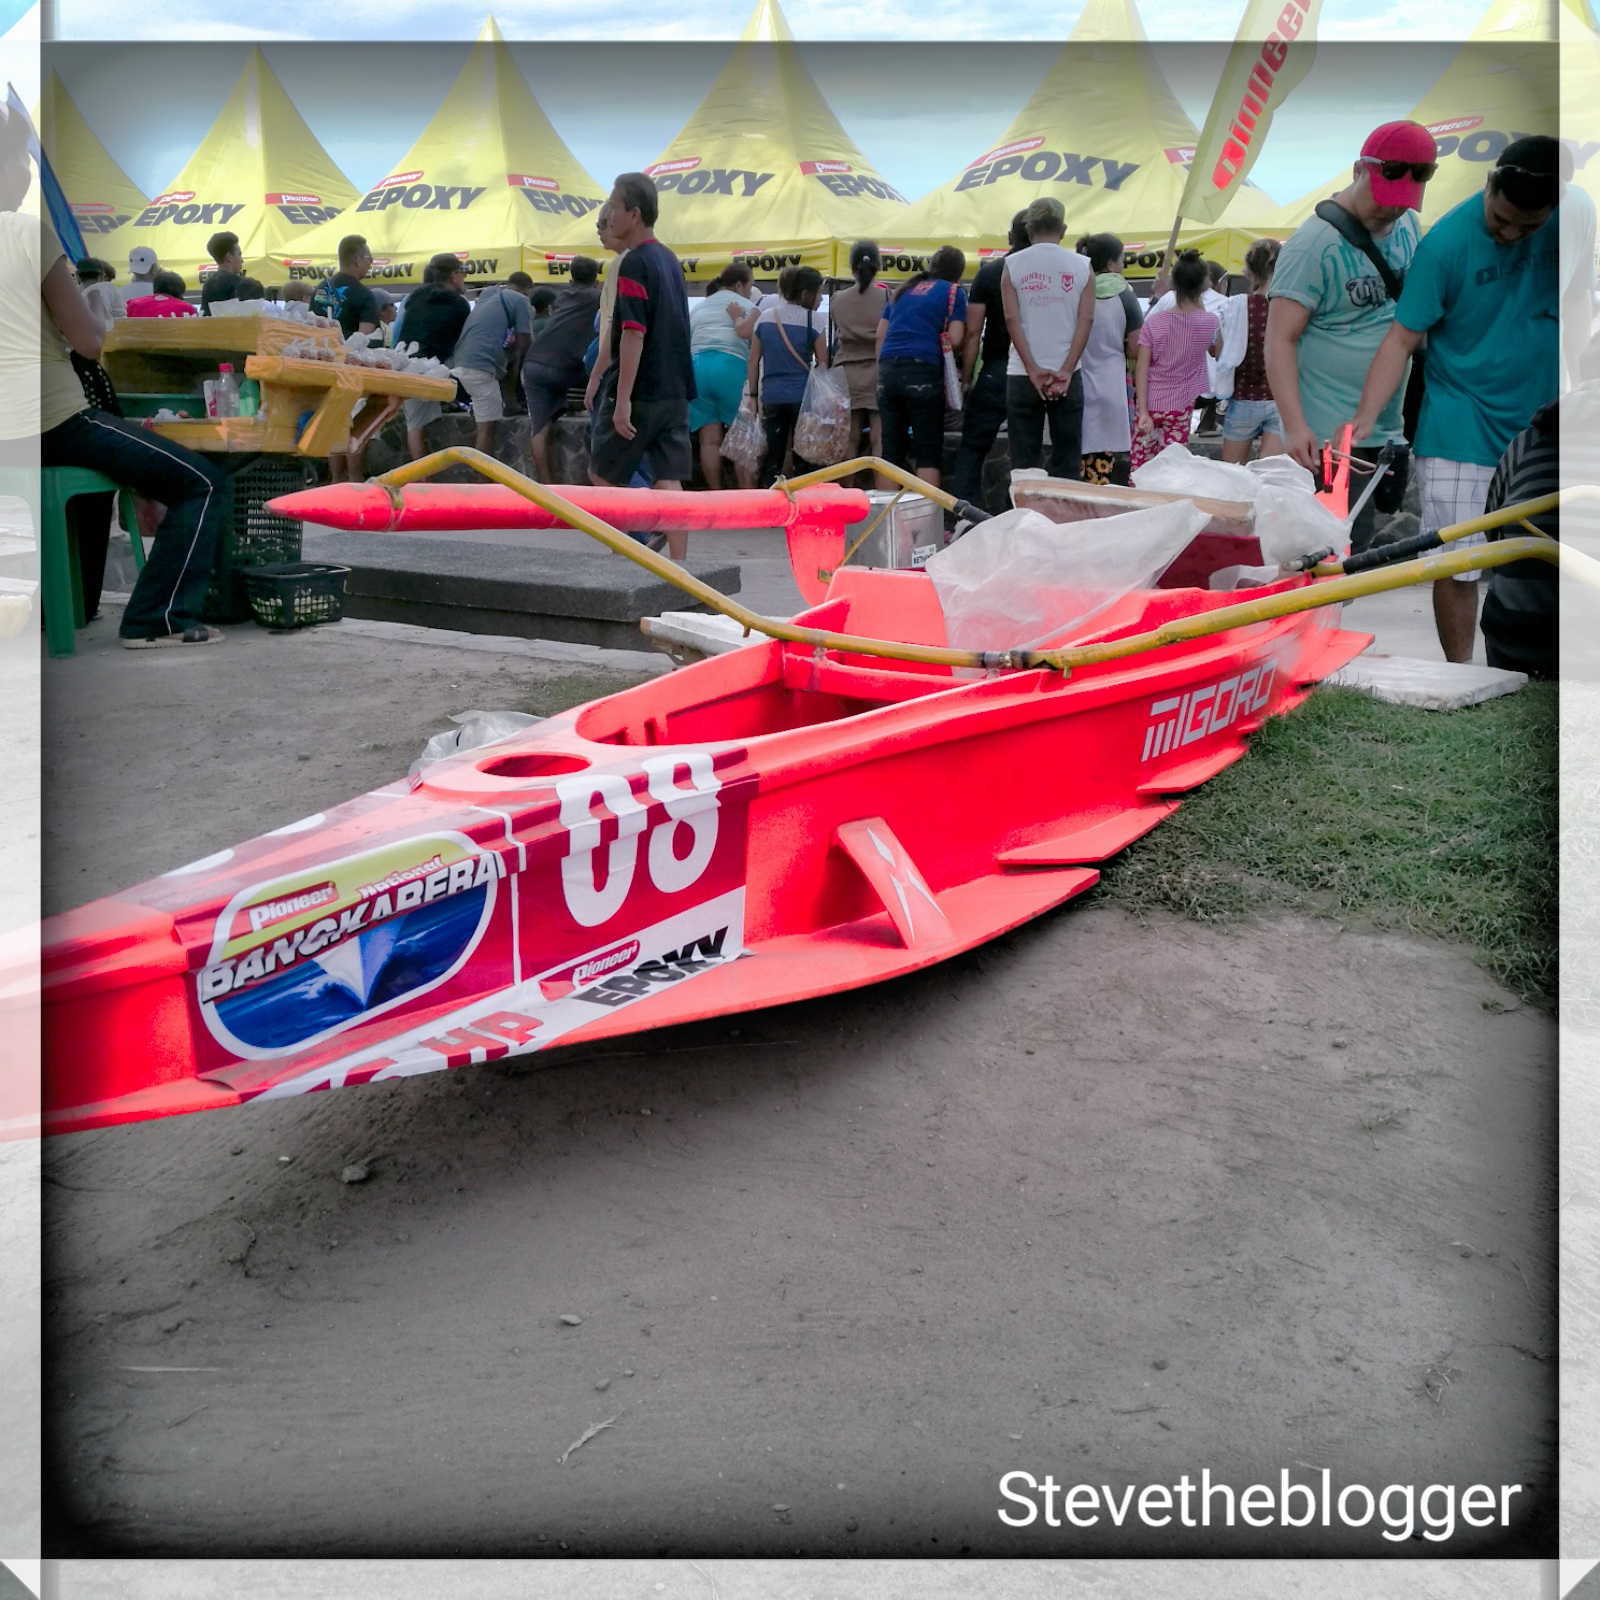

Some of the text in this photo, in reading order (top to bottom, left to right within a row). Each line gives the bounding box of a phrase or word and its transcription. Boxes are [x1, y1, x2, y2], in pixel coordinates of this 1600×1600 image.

[954, 151, 1141, 191] EPOXY
[133, 203, 246, 227] EPOXY
[355, 184, 487, 212] EPOXY
[464, 259, 498, 275] OXY
[555, 753, 723, 928] 08
[357, 856, 445, 899] National
[249, 884, 335, 932] Pioneer
[572, 944, 638, 989] Pioneer
[572, 926, 729, 1007] EPOXY
